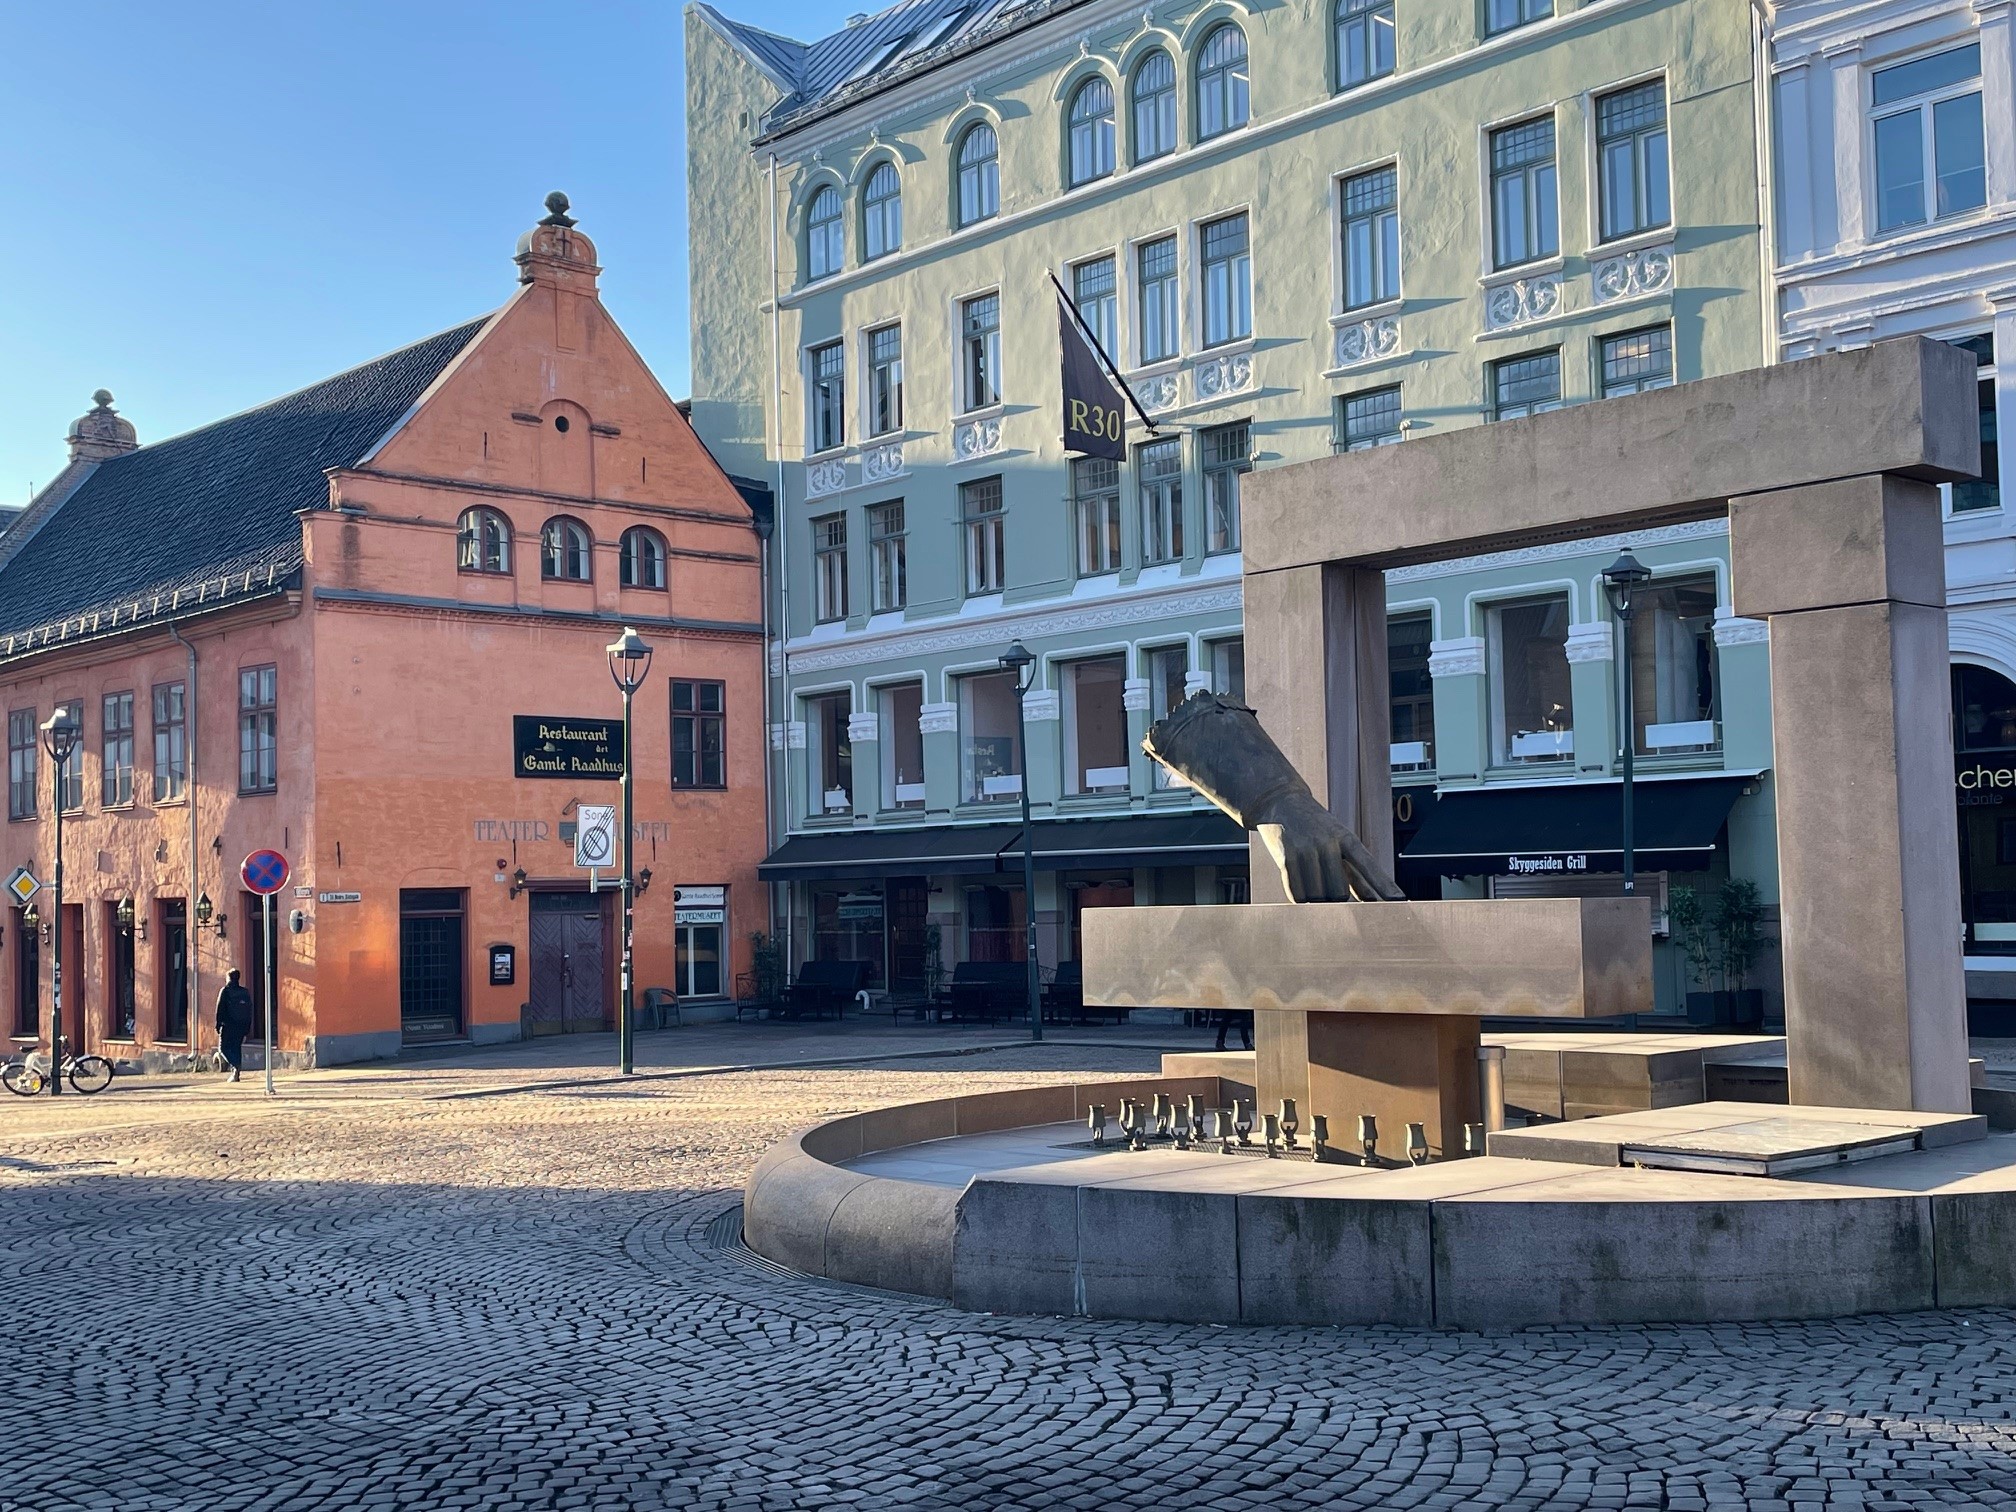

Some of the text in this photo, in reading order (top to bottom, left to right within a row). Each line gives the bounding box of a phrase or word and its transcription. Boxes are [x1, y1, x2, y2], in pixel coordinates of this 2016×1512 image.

[1069, 398, 1121, 442] R30
[539, 724, 608, 741] Restaurant
[595, 744, 608, 753] det
[524, 754, 624, 772] Gamle Raadhus
[1955, 764, 2016, 789] che
[473, 820, 550, 841] TEATER
[1508, 855, 1587, 873] Skyggesiden Grill
